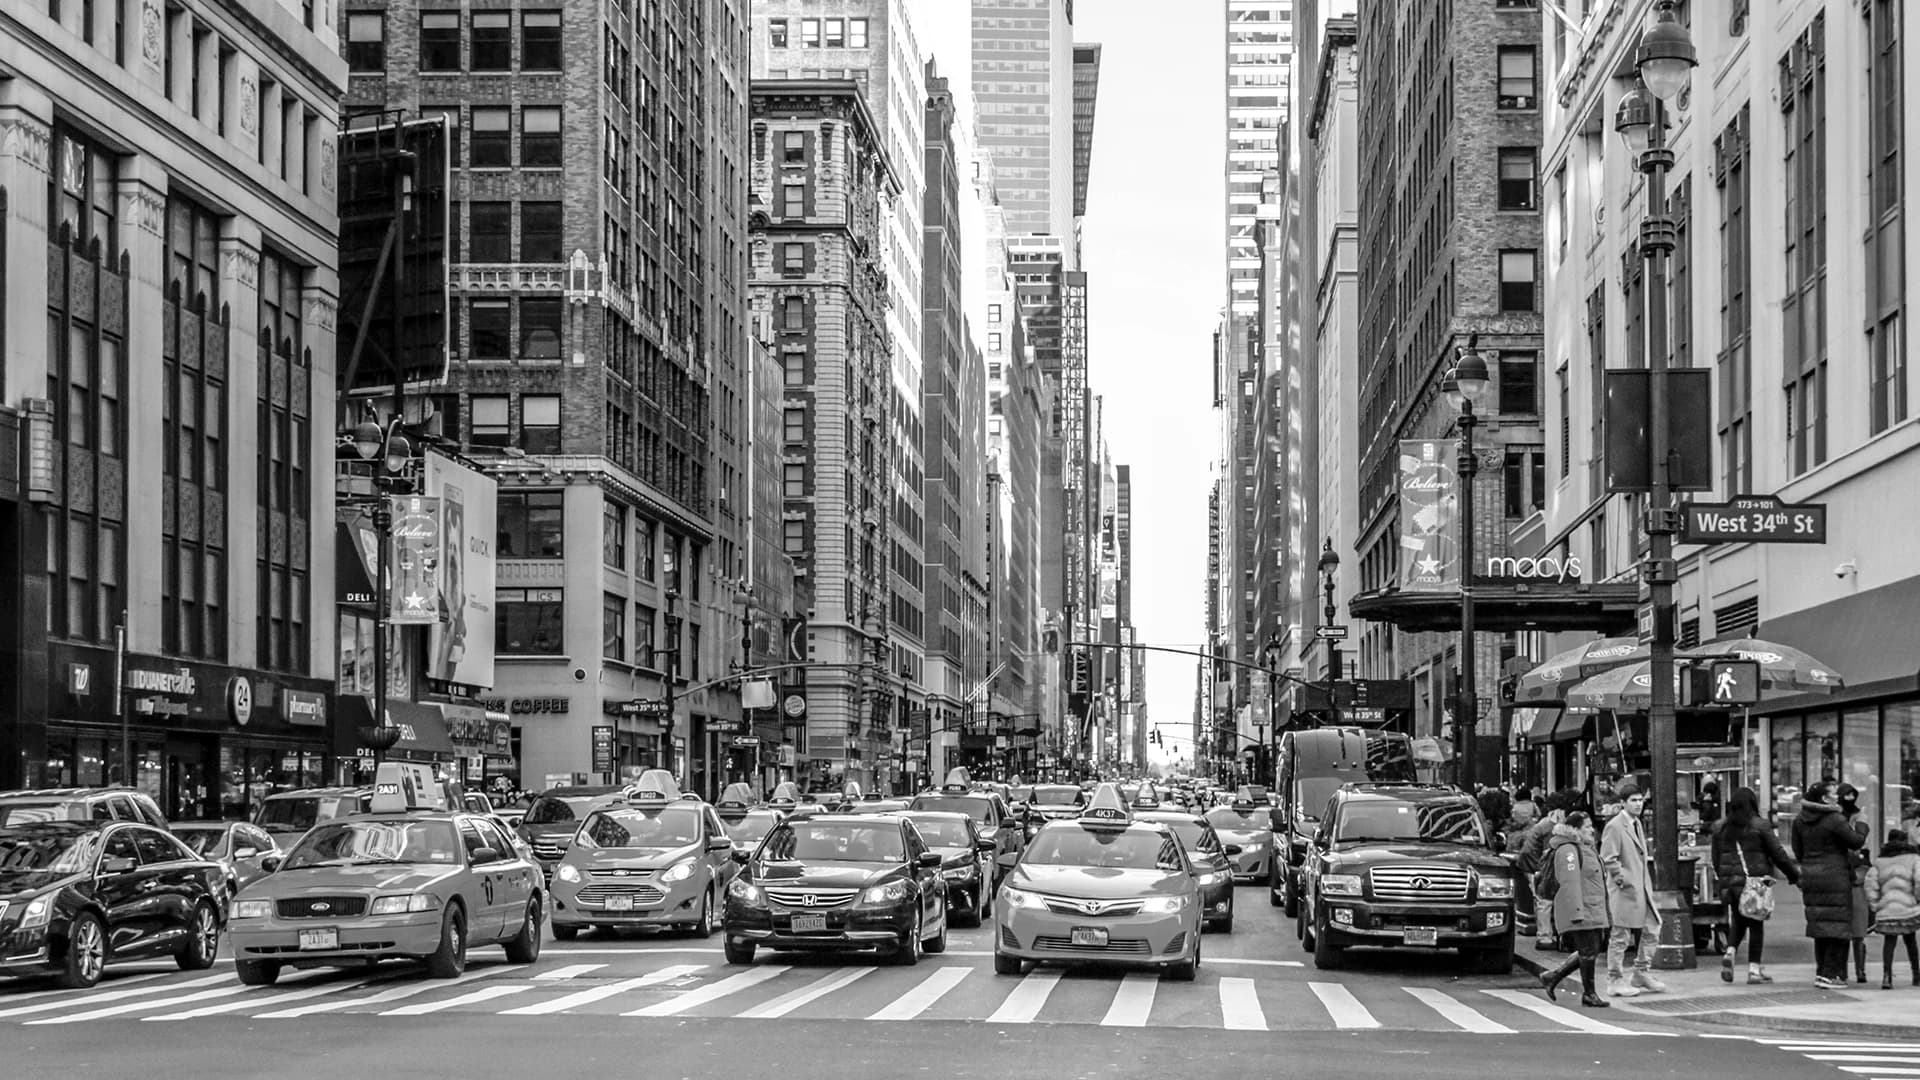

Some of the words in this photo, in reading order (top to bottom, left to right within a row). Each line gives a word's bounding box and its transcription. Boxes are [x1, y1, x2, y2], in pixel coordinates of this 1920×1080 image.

[1403, 473, 1449, 489] Believe
[1697, 513, 1747, 532] West
[1752, 512, 1788, 533] 34th
[1794, 514, 1814, 533] St
[346, 593, 370, 602] DELI
[238, 685, 248, 707] 24
[511, 699, 569, 714] COFFEE
[378, 785, 398, 795] 2A31
[1095, 809, 1116, 819] 4K37
